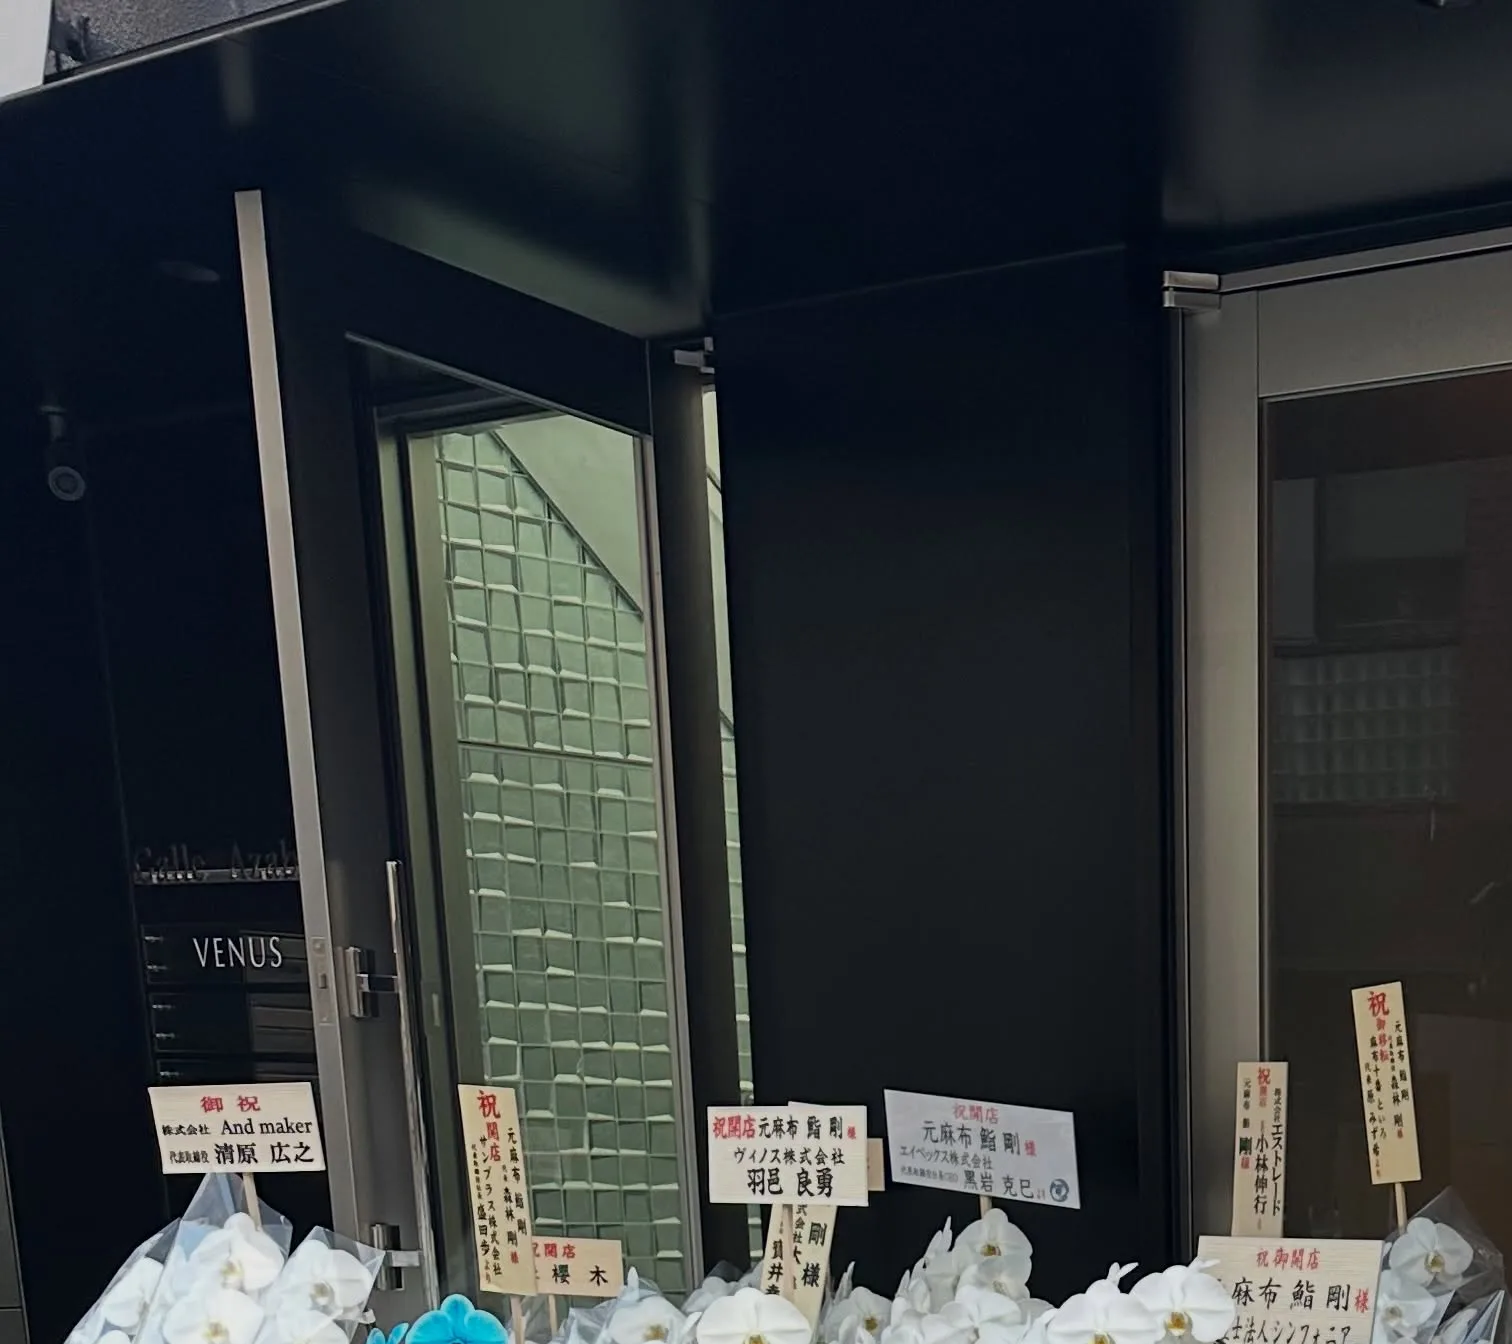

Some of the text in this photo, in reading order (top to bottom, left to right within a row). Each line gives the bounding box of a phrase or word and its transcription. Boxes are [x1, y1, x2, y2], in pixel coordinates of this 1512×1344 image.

[193, 936, 282, 968] VENUS
[162, 1117, 312, 1136] 株式会社 And maker
[713, 1114, 757, 1140] 祝開店
[758, 1115, 799, 1140] 元麻布
[922, 1121, 972, 1149] 元麻布
[214, 1142, 258, 1165] 清原
[270, 1142, 315, 1164] 広之
[734, 1147, 846, 1166] ヴィノス株式会社
[1271, 1124, 1284, 1217] エストレード
[1217, 1276, 1281, 1310] 麻布
